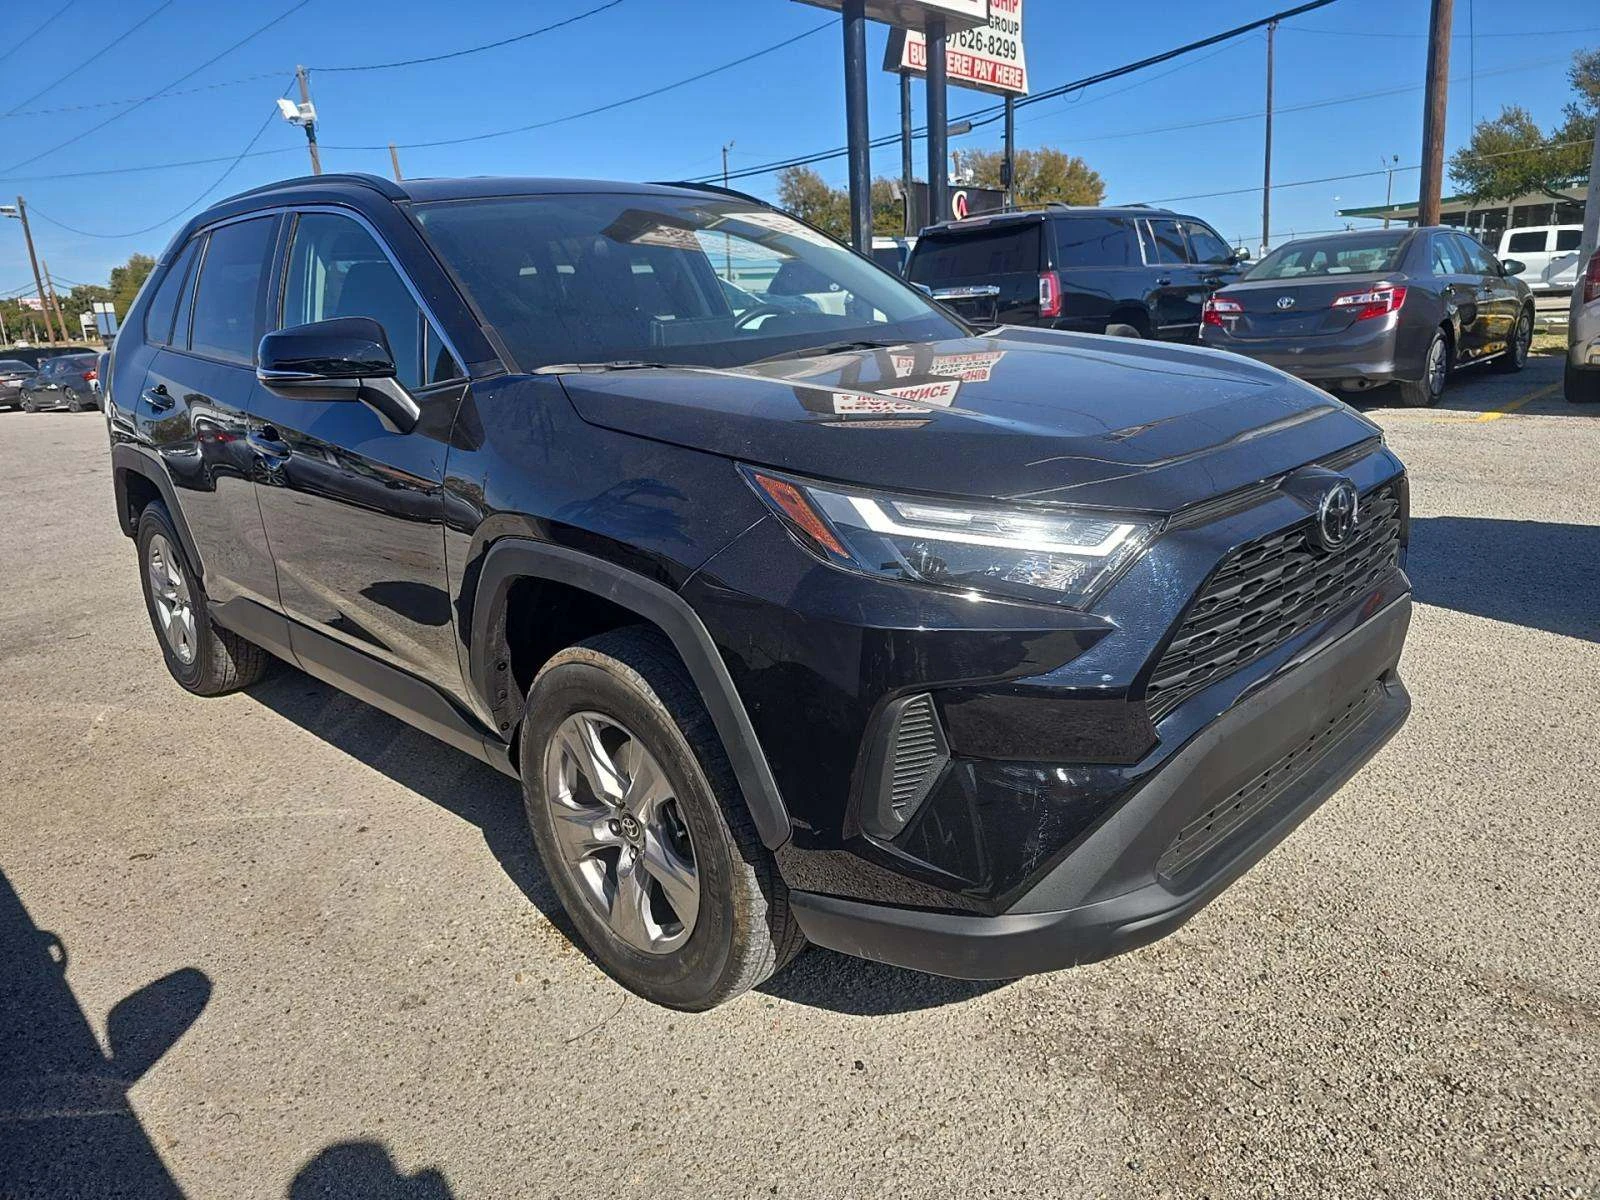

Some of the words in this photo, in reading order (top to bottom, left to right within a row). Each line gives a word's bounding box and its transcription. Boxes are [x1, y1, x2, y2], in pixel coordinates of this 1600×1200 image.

[990, 0, 1018, 13] SHIP
[988, 15, 1019, 36] GROUP
[911, 45, 926, 66] BU
[948, 53, 972, 76] ERE!
[974, 60, 995, 82] PAY
[995, 65, 1022, 87] HERE
